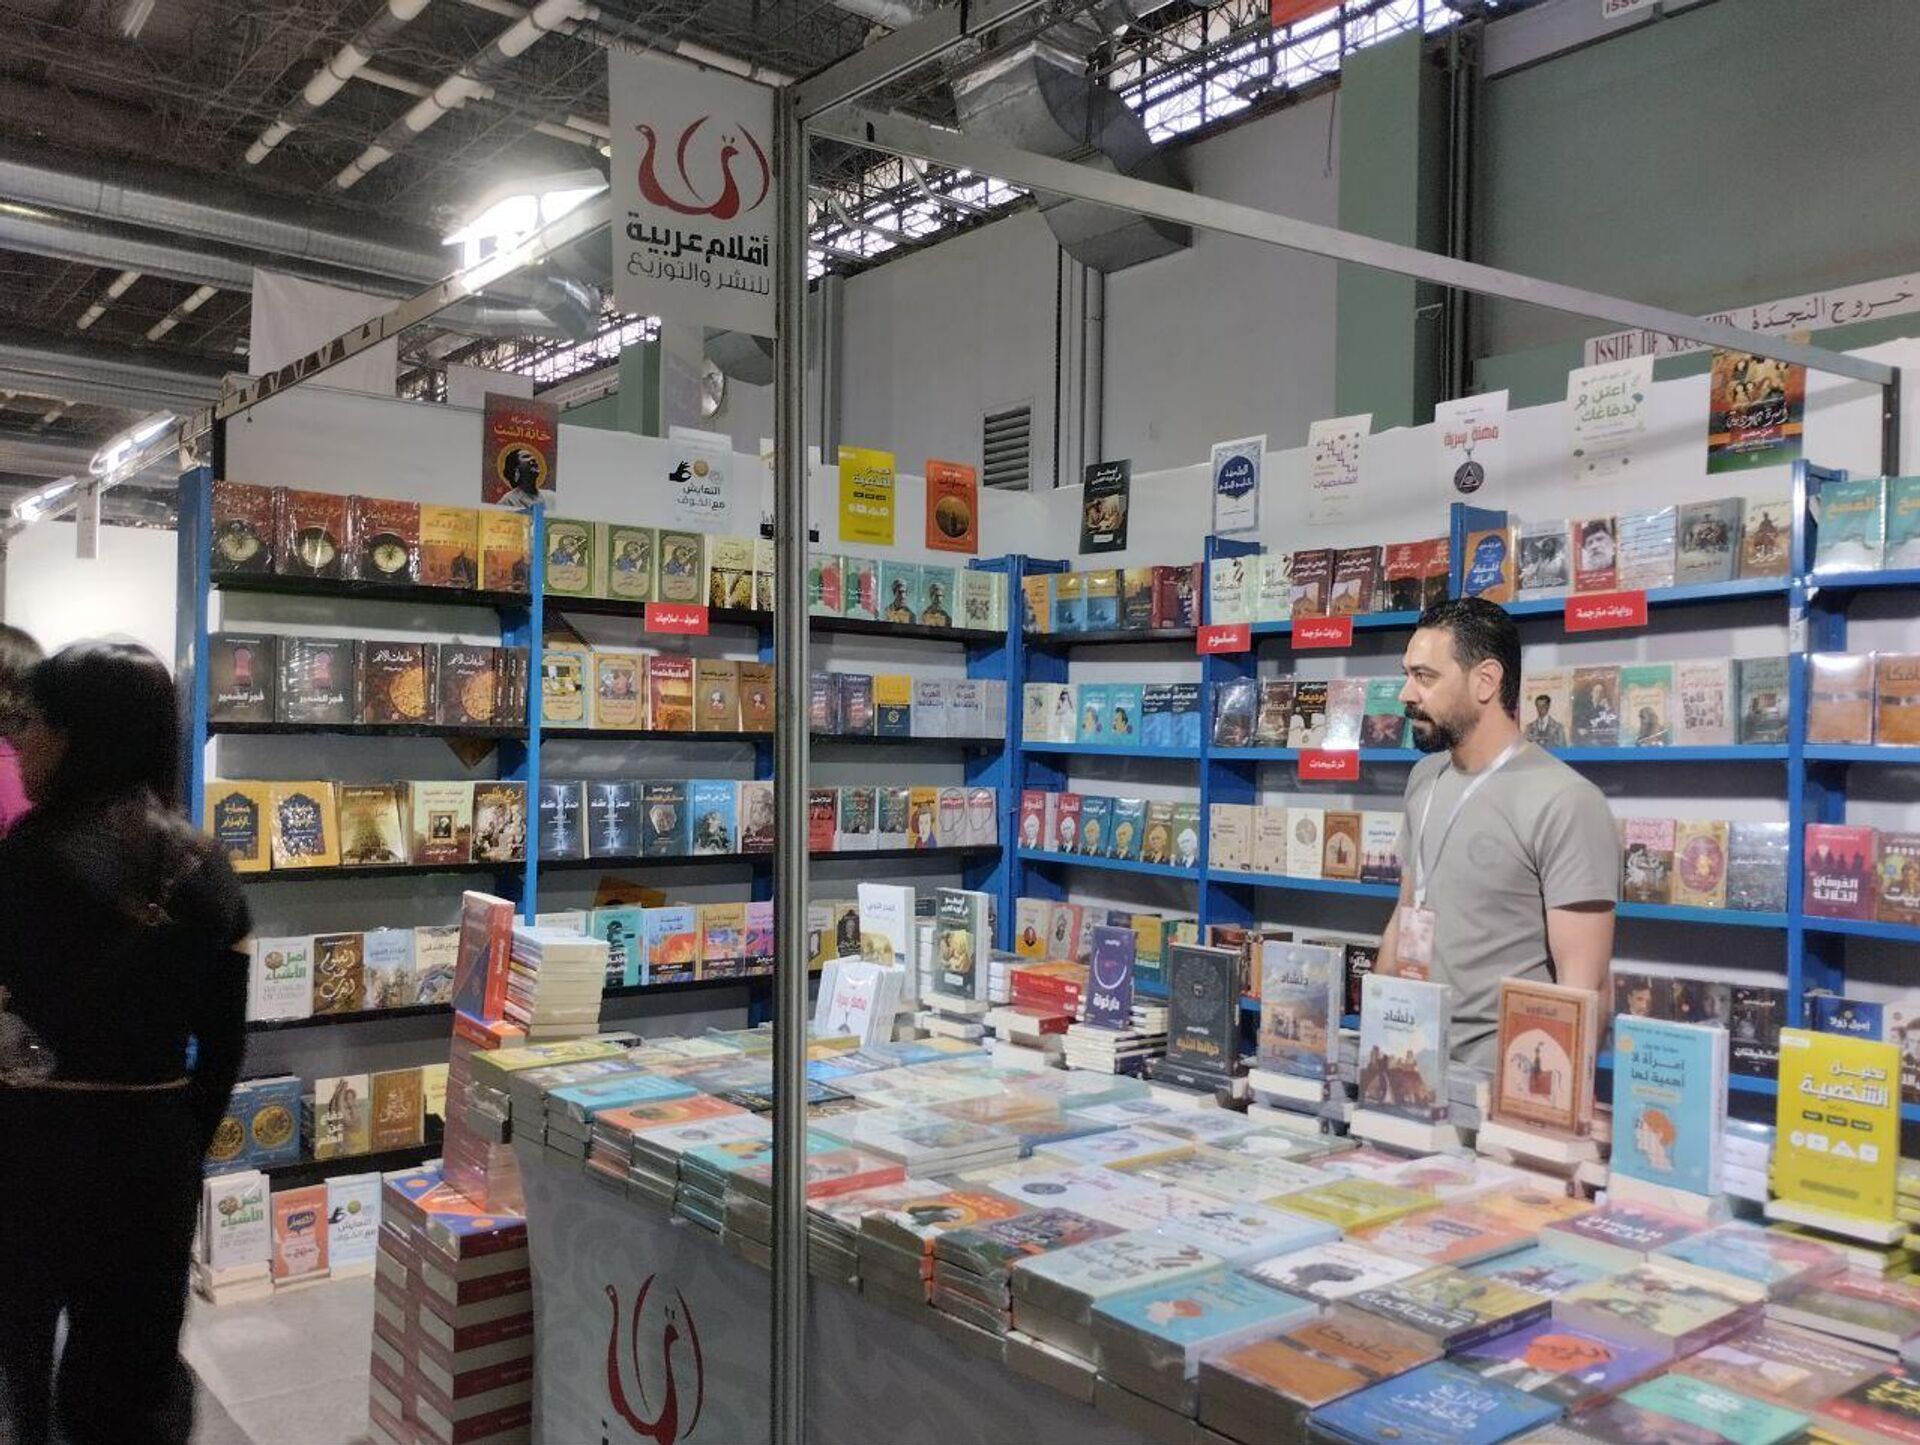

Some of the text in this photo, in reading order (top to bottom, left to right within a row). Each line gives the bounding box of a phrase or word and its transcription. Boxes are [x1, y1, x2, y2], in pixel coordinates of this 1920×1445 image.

[626, 211, 768, 266] أقلام عربية
[627, 252, 770, 295] للنشر والتوزيع
[1831, 280, 1914, 323] خروج
[1383, 1005, 1415, 1025] دلشاد
